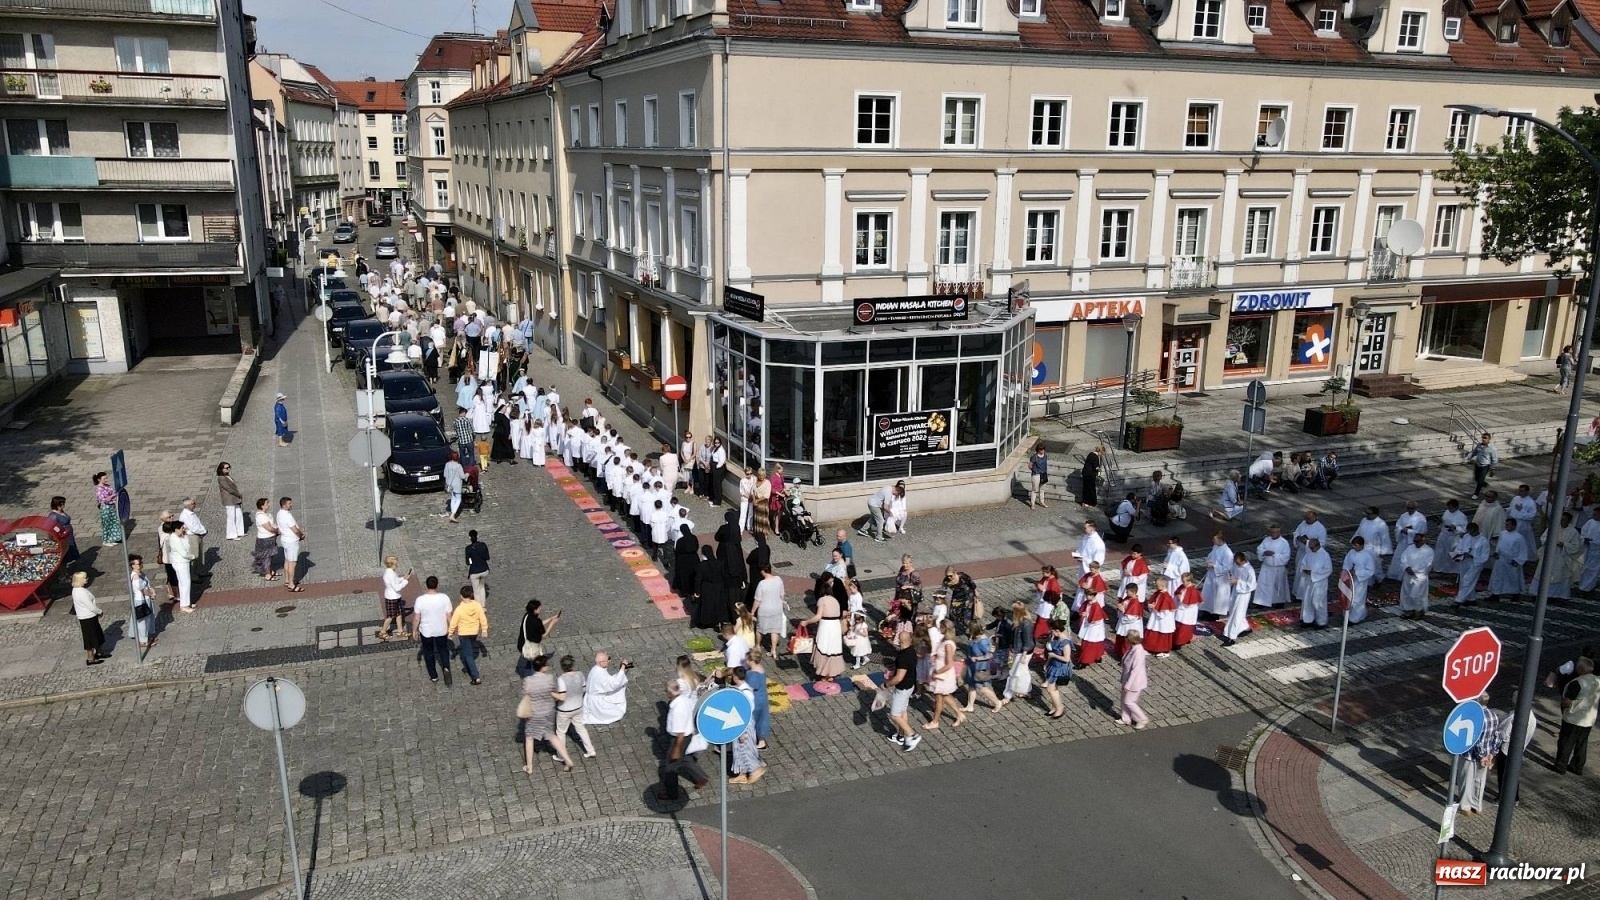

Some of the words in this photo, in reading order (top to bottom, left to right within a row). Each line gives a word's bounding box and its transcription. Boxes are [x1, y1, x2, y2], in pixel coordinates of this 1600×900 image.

[875, 302, 898, 311] INDIAN
[899, 300, 926, 309] MASALA
[927, 299, 954, 308] KITCHEN
[1071, 300, 1143, 318] APTEKA
[1237, 291, 1311, 310] ZDROWIT
[880, 427, 903, 437] WIELKIE
[1451, 651, 1495, 680] STOP
